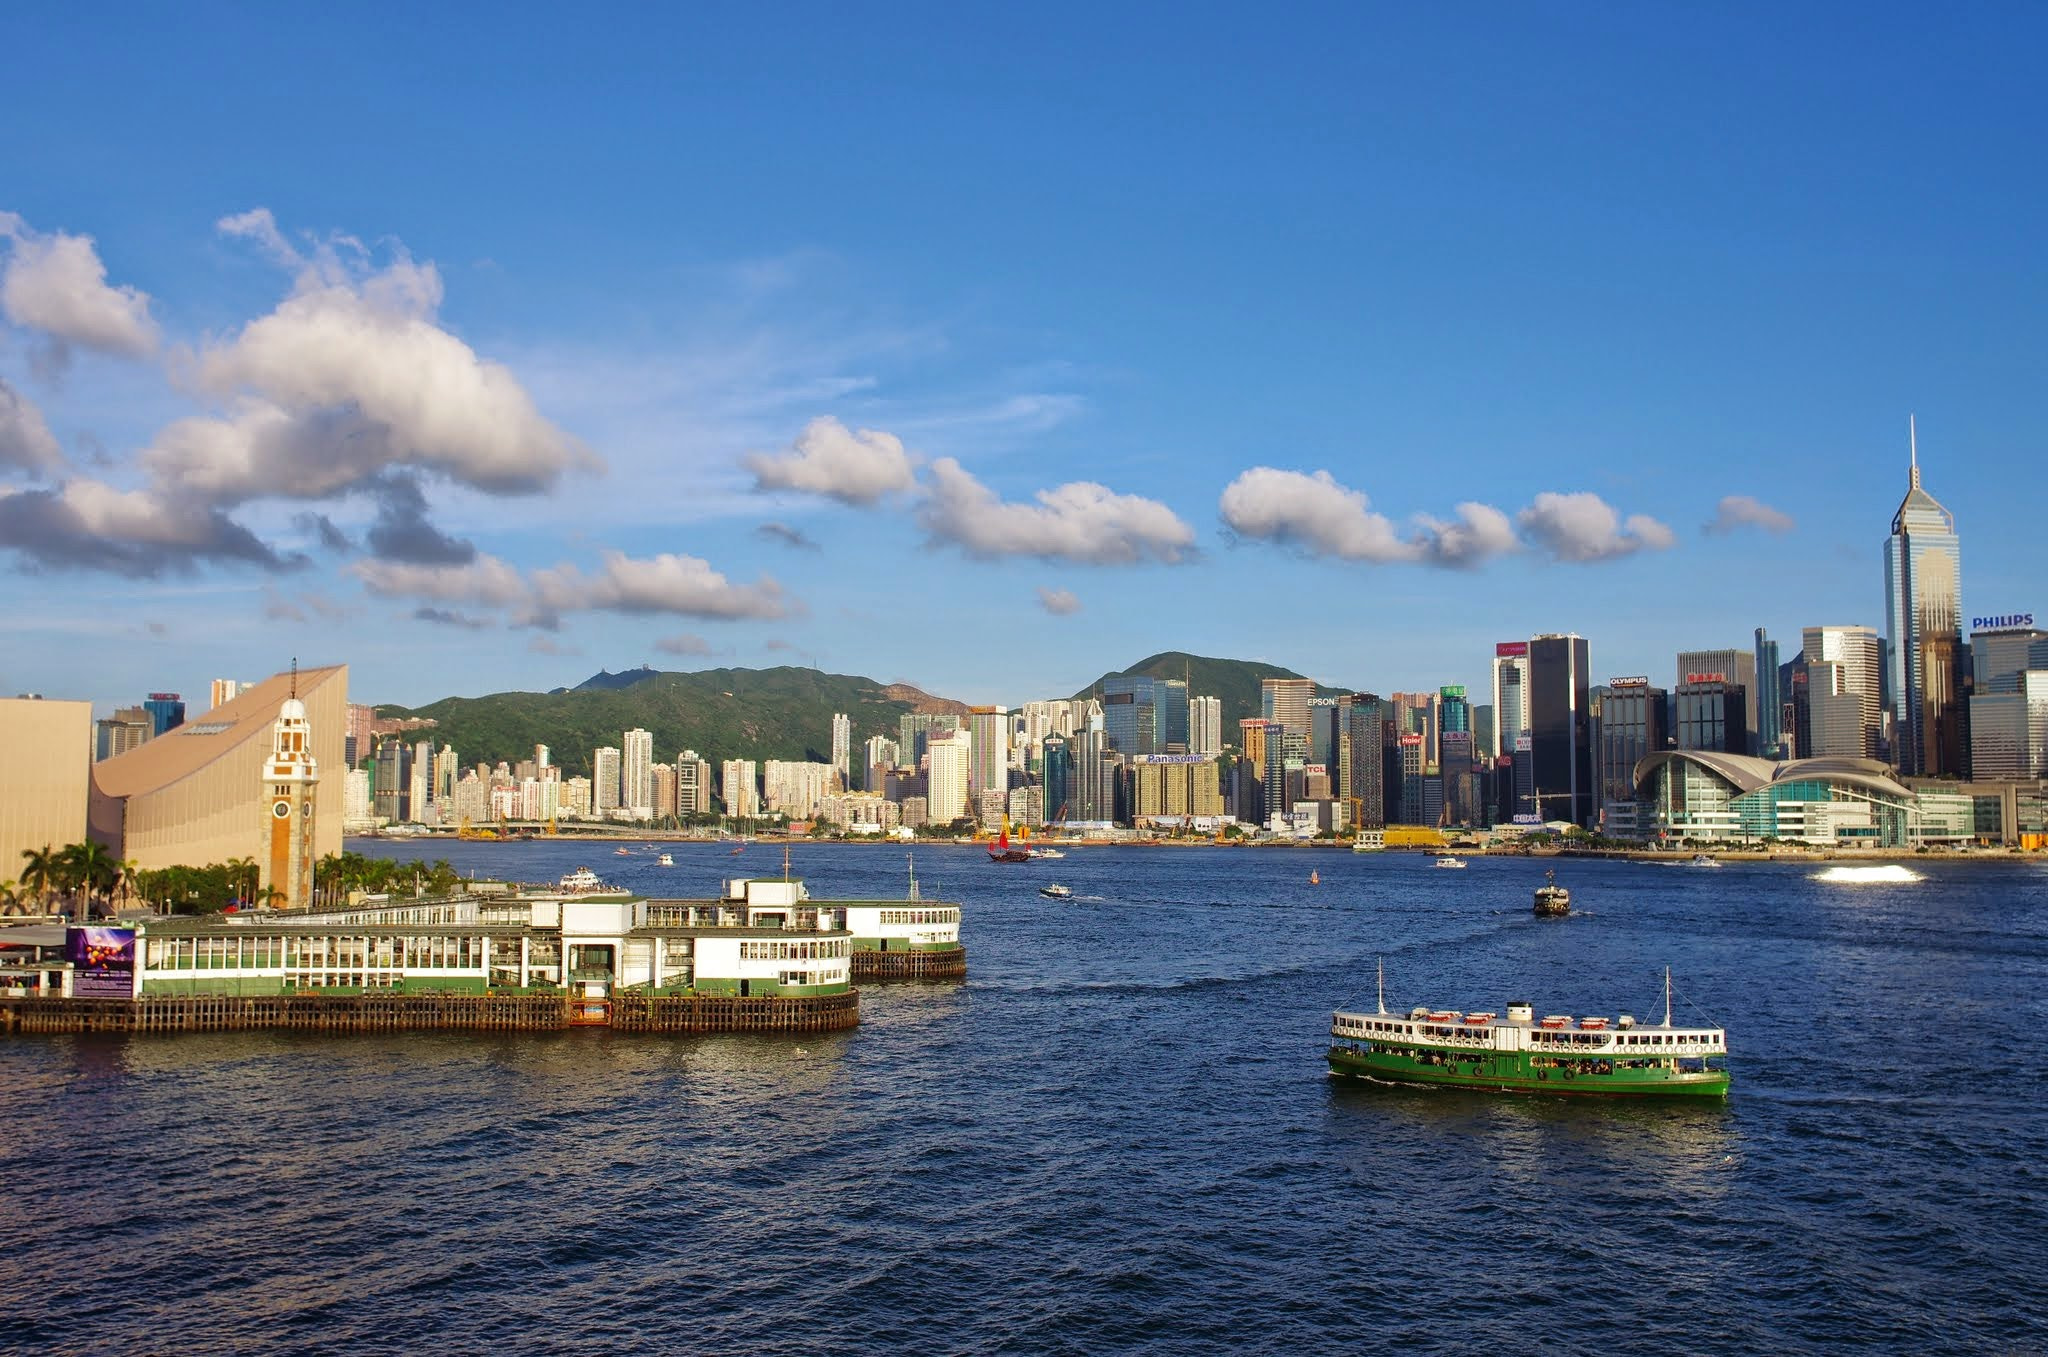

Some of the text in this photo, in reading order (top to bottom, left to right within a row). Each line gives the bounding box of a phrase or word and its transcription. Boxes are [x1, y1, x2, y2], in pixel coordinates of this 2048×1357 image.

[1973, 614, 2033, 628] PHILIPS
[1611, 677, 1647, 685] OLYMPUS
[1307, 698, 1335, 706] EPSON
[1148, 754, 1203, 763] Panasonic
